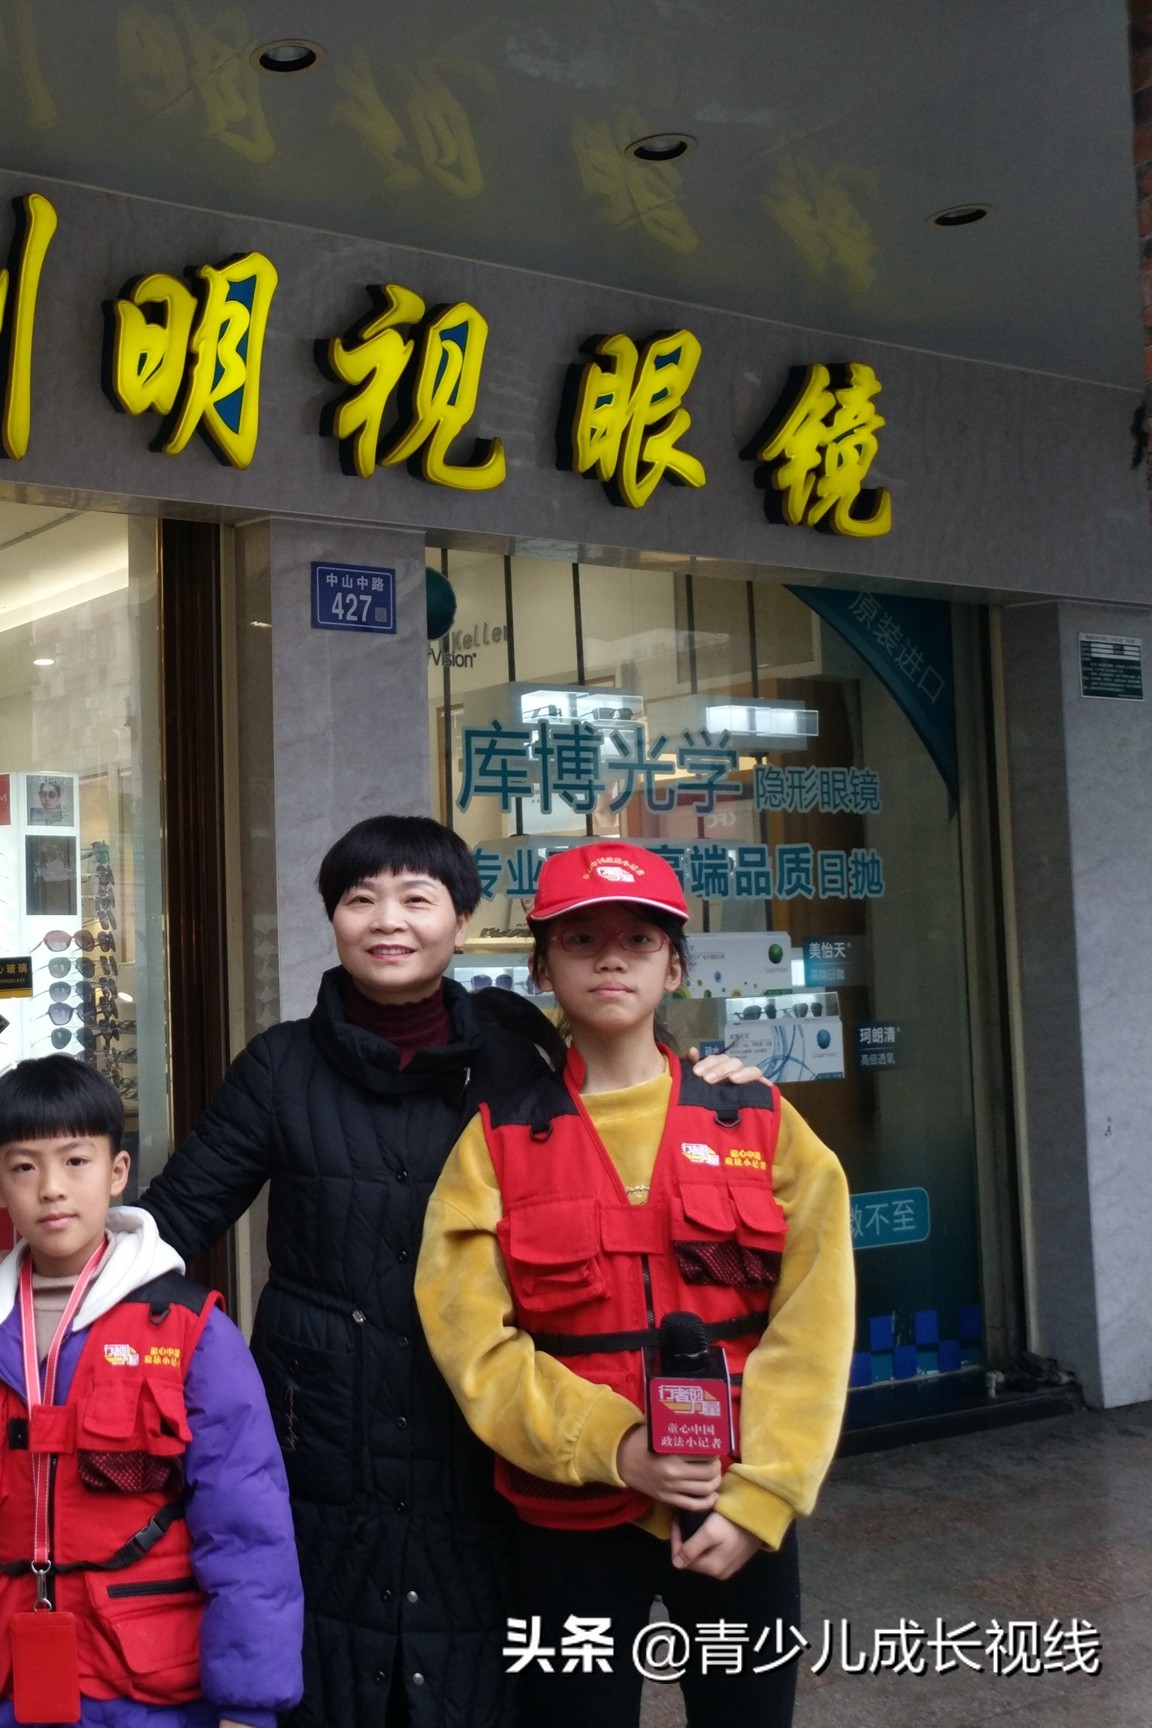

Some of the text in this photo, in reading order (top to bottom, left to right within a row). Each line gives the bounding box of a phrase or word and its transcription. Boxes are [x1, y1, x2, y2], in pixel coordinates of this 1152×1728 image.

[326, 572, 384, 592] 中山中路
[331, 592, 372, 622] 427
[849, 591, 945, 704] 原装进口
[459, 720, 882, 814] 库博光学 隐形眼镜
[809, 942, 847, 959] 美怡天
[859, 1027, 895, 1044] 珂朗清
[668, 1422, 715, 1436] 童心中国
[661, 1435, 722, 1449] 政法小记者
